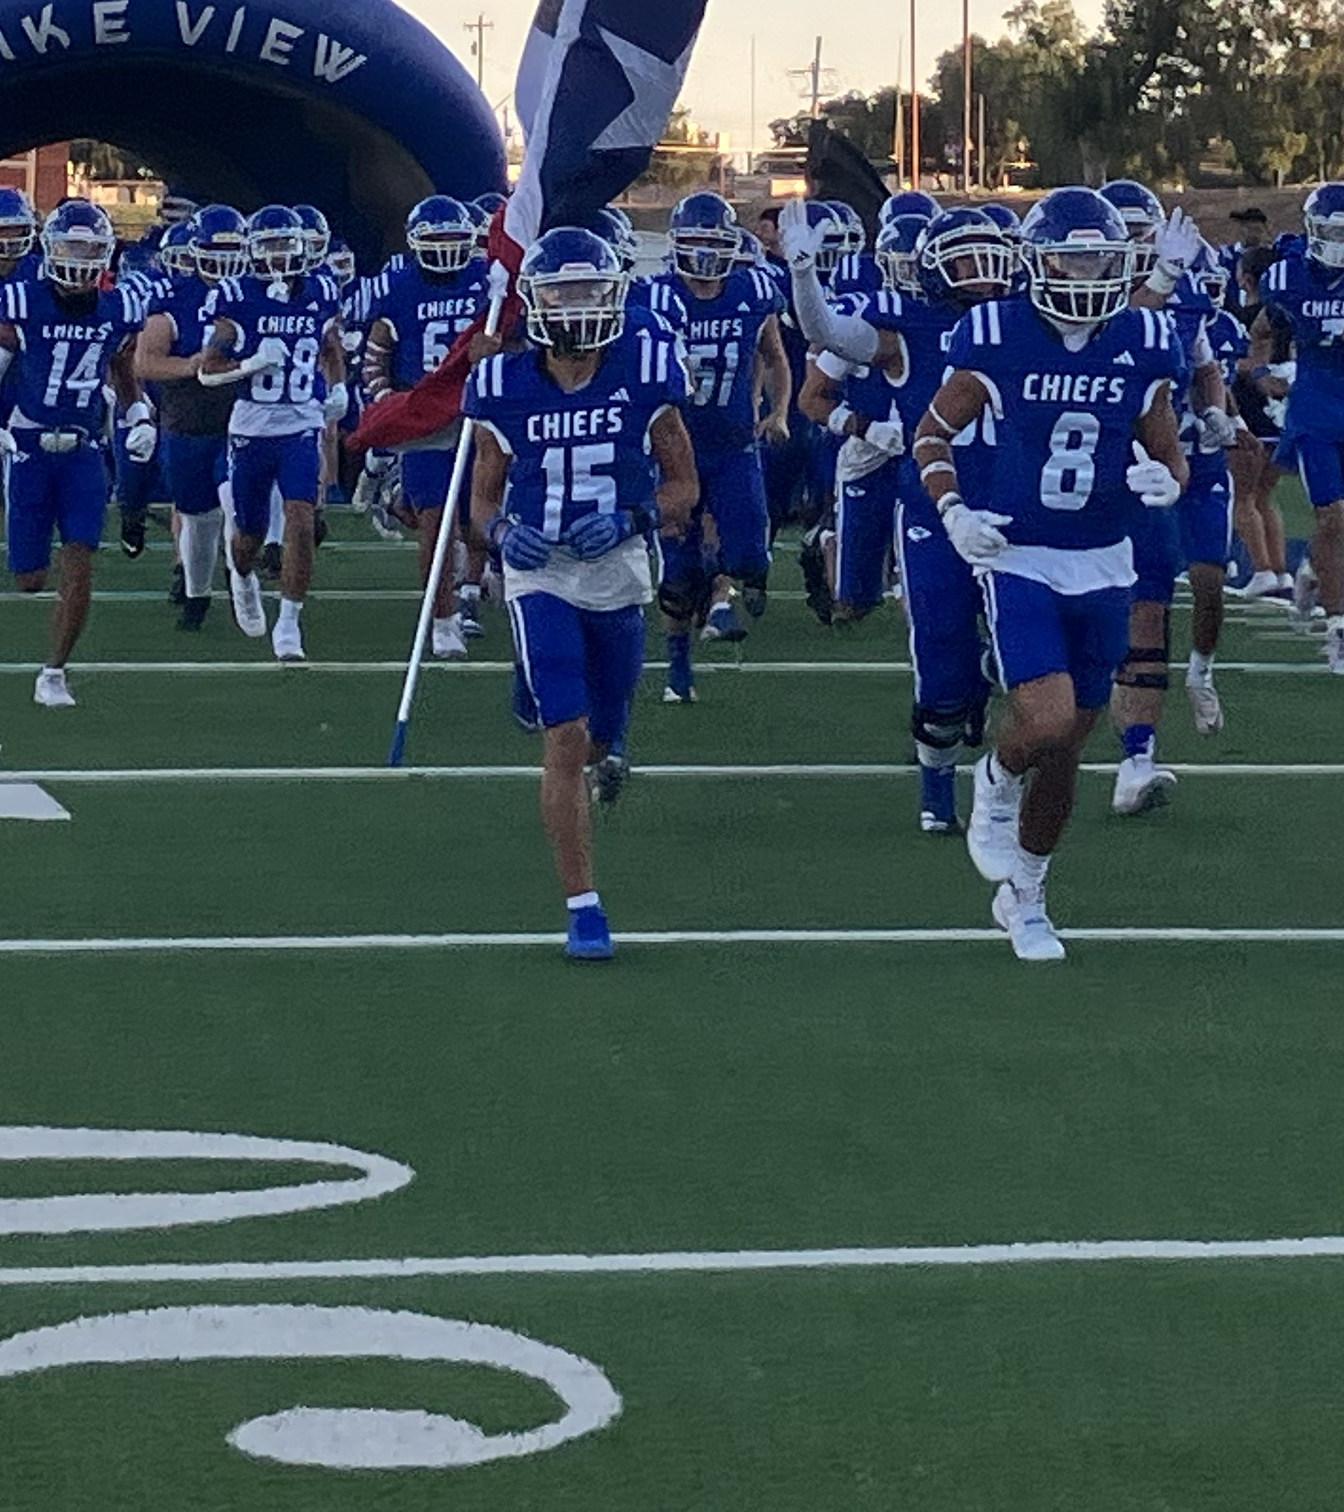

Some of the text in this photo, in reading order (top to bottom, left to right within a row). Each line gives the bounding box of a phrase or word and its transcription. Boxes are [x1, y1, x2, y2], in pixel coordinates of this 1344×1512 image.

[175, 0, 367, 84] VIEW
[257, 316, 316, 335] CHIEFS
[418, 297, 476, 320] CHIEFS
[689, 318, 743, 339] HIEFS
[423, 318, 474, 373] 6
[43, 341, 104, 408] 14
[1022, 373, 1126, 404] CHIEFS
[527, 406, 624, 443] CHIEFS
[1040, 411, 1101, 511] 8
[541, 441, 618, 542] 15
